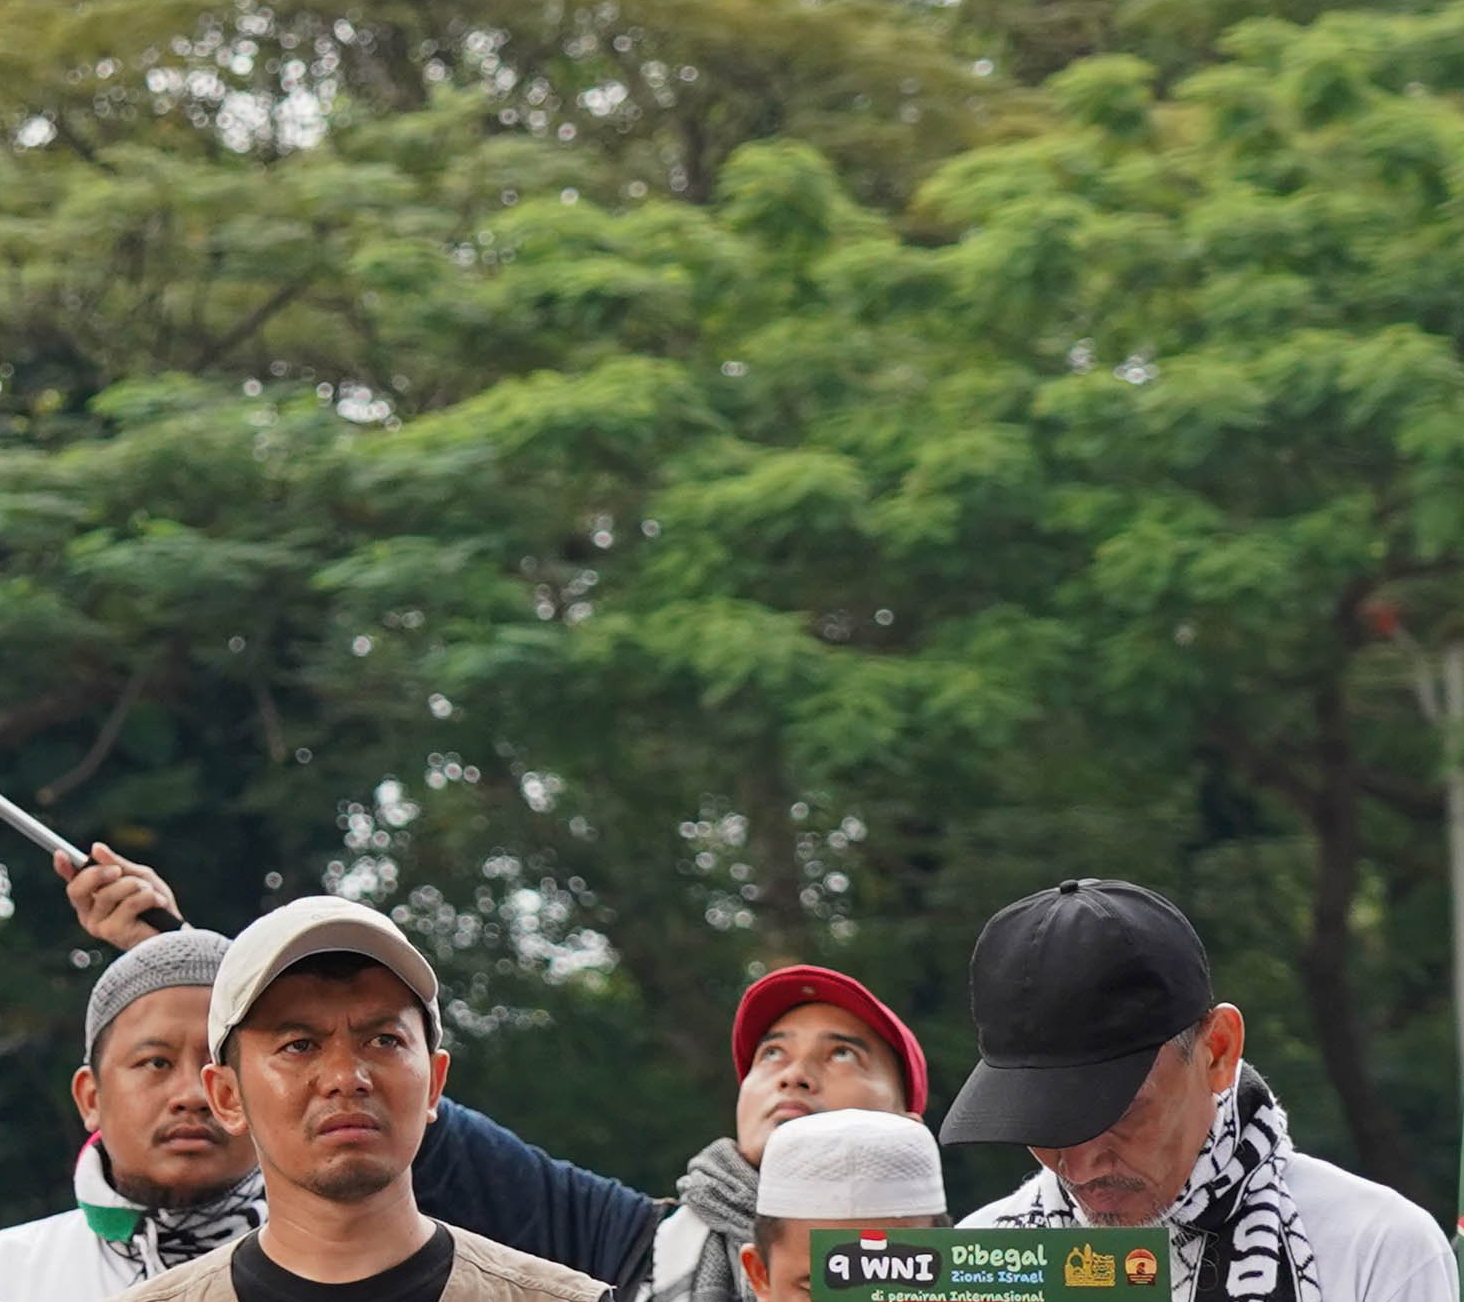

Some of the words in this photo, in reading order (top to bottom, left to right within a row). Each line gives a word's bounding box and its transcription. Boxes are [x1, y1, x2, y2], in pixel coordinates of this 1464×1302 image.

[828, 1254, 850, 1280] 9
[861, 1254, 934, 1281] WNI
[951, 1244, 1048, 1272] Dibegal
[951, 1270, 994, 1283] Zionis
[997, 1270, 1044, 1284] Israel
[871, 1290, 884, 1302] di
[888, 1291, 946, 1302] perairan
[949, 1290, 1044, 1302] Internasional
